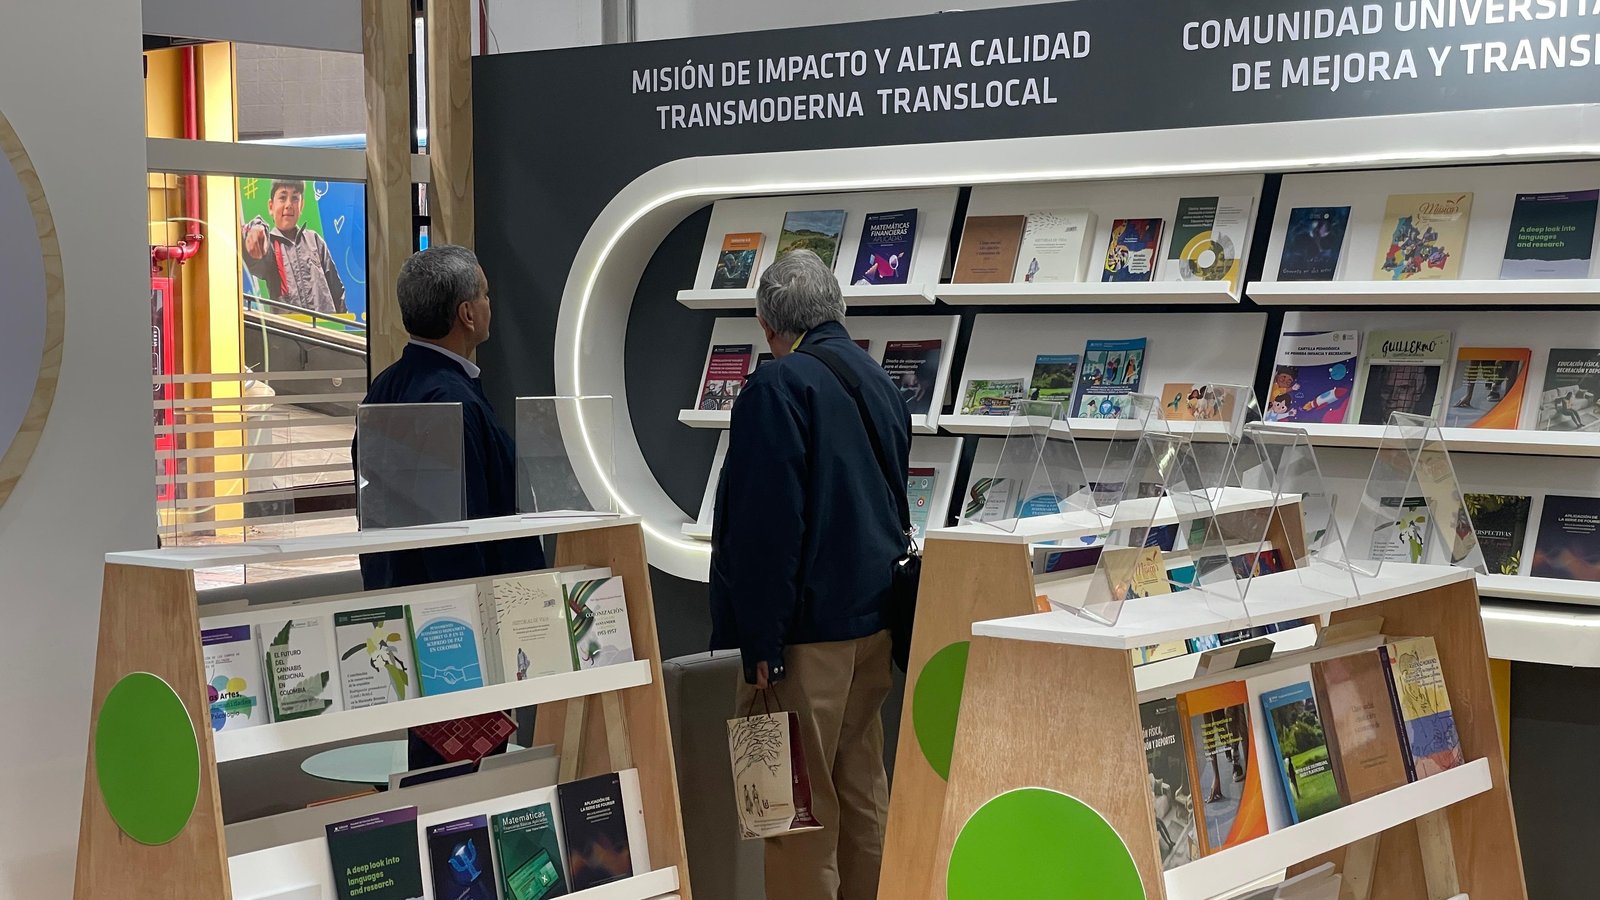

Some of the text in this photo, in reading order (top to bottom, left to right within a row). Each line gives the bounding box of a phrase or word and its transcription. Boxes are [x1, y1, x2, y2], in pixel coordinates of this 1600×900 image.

[1183, 4, 1383, 51] COMUNIDAD
[632, 30, 1091, 94] MISIÓN DE IMPACTO Y ALTA CALIDAD
[1232, 33, 1600, 93] DE MEJORA Y TRANS
[656, 77, 1058, 130] TRANSMODERNA TRANSLOCAL
[1526, 226, 1544, 234] deep
[276, 665, 302, 673] CANNABIS
[277, 672, 305, 680] MEDICINAL
[280, 687, 306, 696] COLOMBIA
[502, 811, 546, 826] Matemáticas
[346, 856, 400, 876] A deep look into
[347, 871, 384, 886] languages
[350, 878, 394, 896] and research
